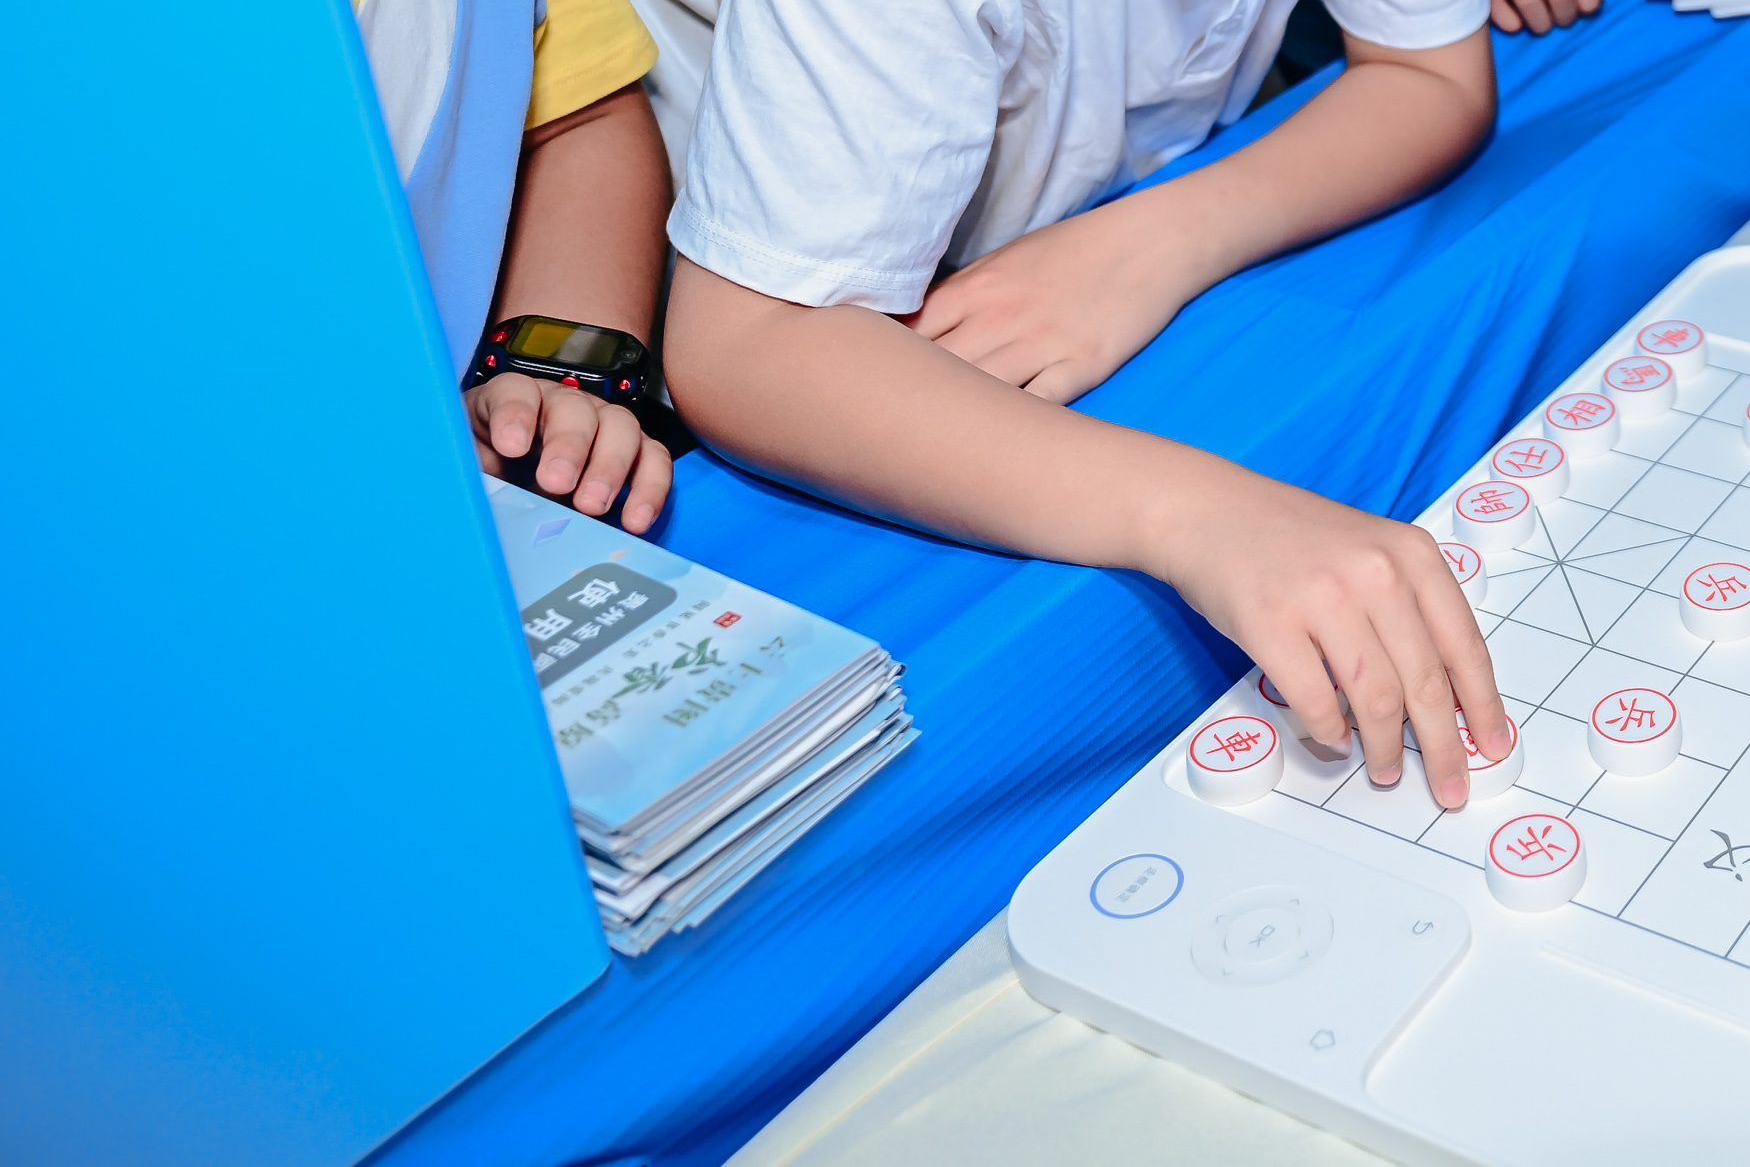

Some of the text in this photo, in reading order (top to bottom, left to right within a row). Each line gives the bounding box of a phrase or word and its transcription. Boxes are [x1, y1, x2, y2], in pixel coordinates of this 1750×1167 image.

[1558, 400, 1606, 425] 相
[1506, 446, 1548, 472] 仕
[1470, 490, 1514, 514] 帥
[1696, 574, 1748, 602] 兵
[1605, 698, 1656, 732] 兵
[1206, 731, 1262, 762] 車
[1506, 825, 1567, 861] 兵
